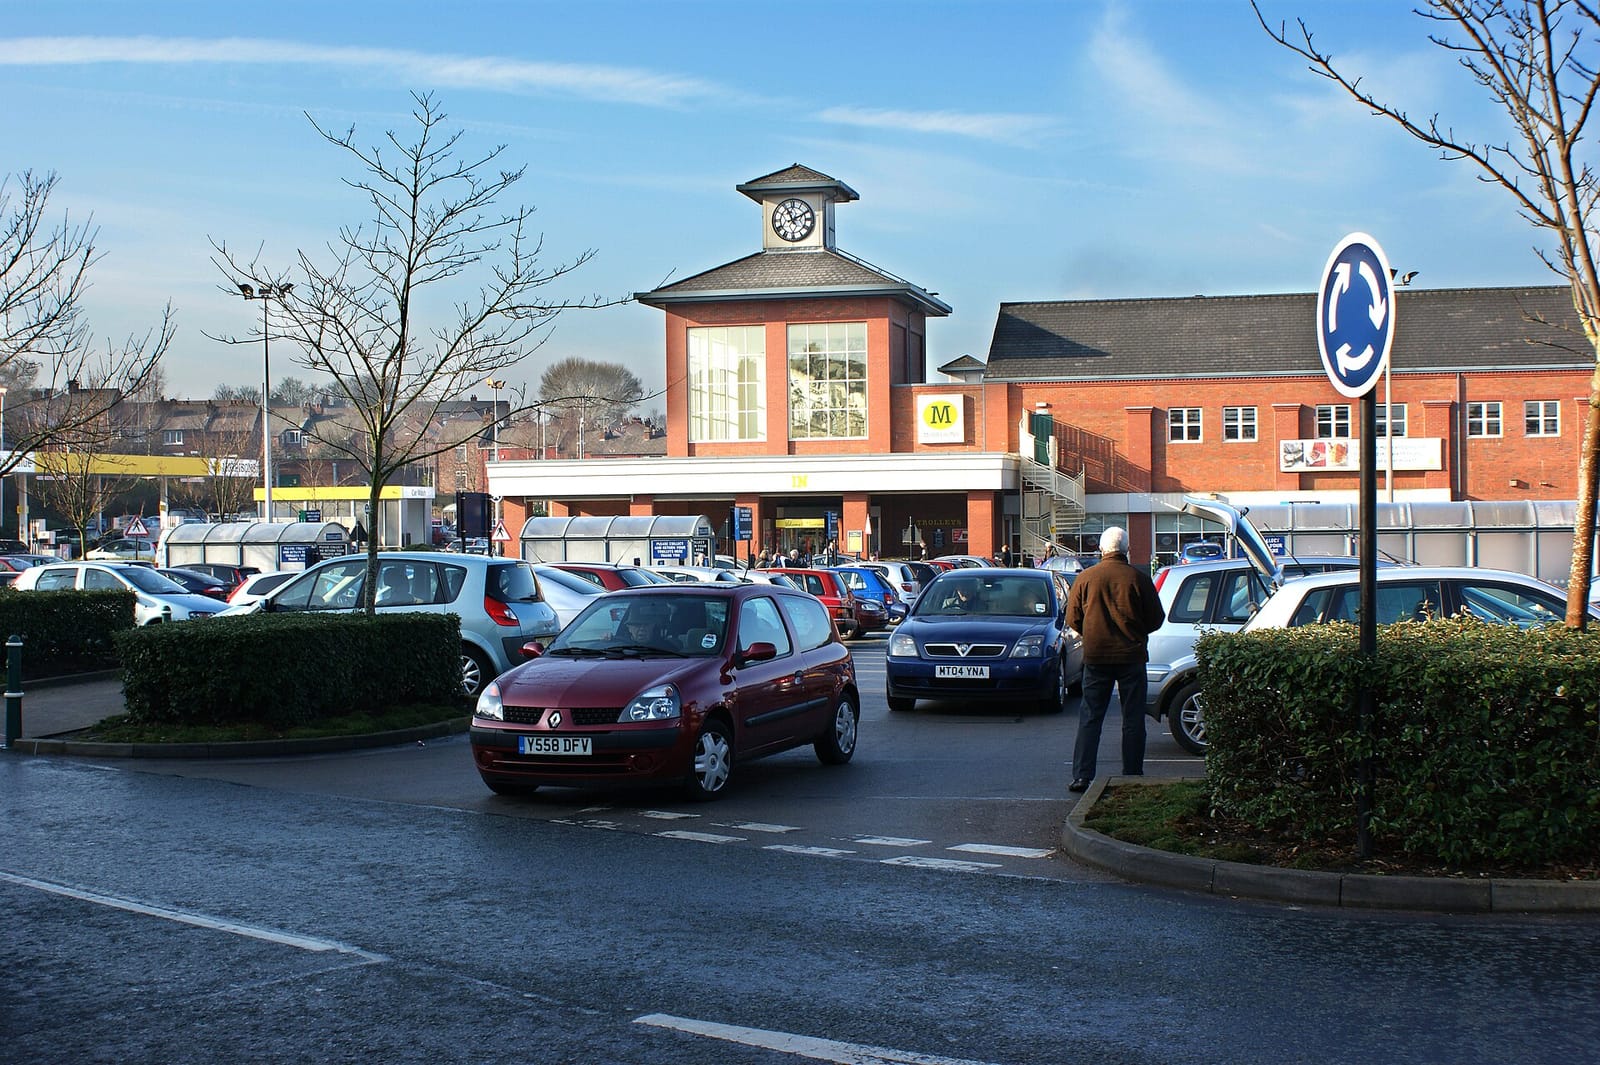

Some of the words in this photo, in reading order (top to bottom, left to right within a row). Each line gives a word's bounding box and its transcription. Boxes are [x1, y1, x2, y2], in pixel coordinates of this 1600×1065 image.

[930, 405, 952, 424] M
[791, 475, 808, 488] IN
[966, 667, 985, 676] YNA
[527, 738, 560, 752] Y558
[563, 738, 589, 752] DFV
